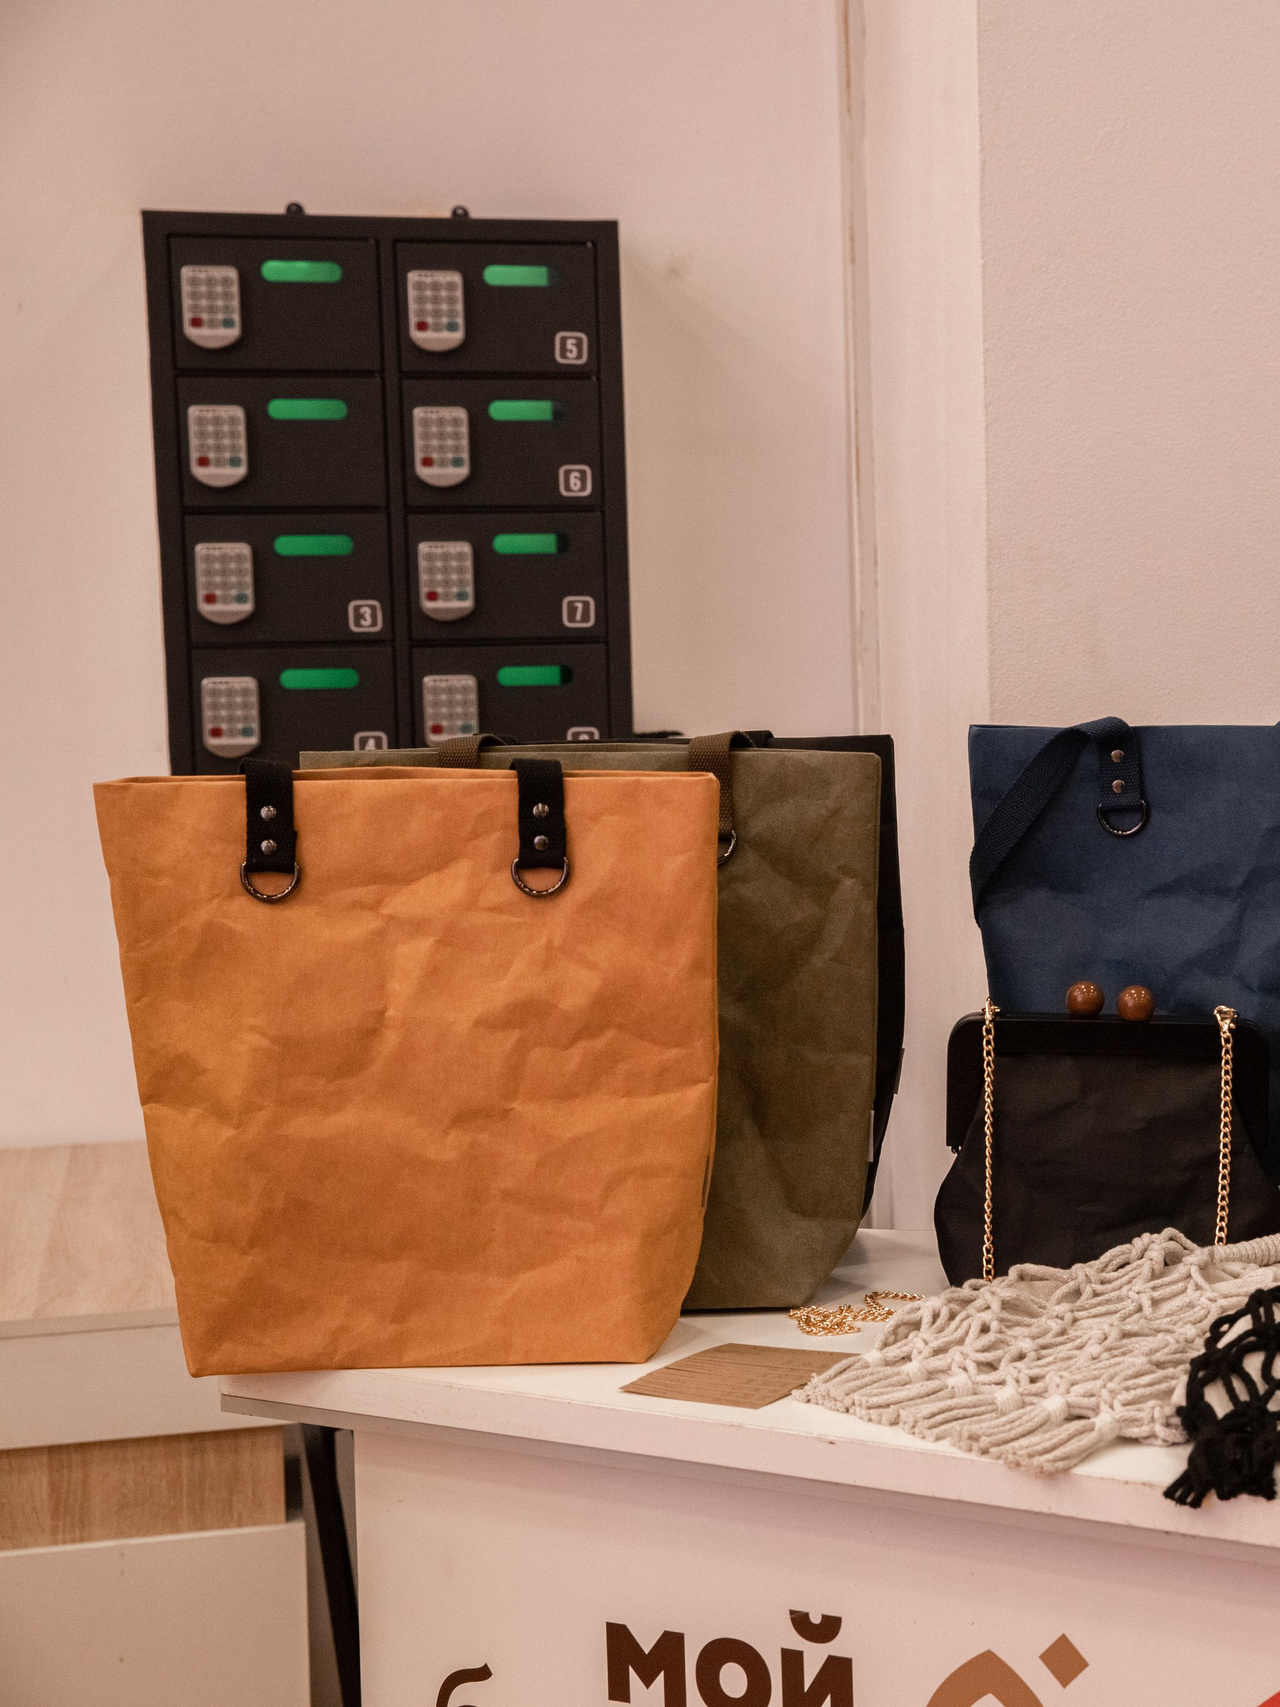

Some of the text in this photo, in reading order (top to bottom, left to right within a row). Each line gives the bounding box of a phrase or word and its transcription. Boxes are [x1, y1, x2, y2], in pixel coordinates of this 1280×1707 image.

[565, 338, 577, 359] 5
[569, 471, 581, 492] 6
[359, 606, 372, 627] 3
[573, 602, 584, 623] 7
[606, 1609, 854, 1707] МОЙ
